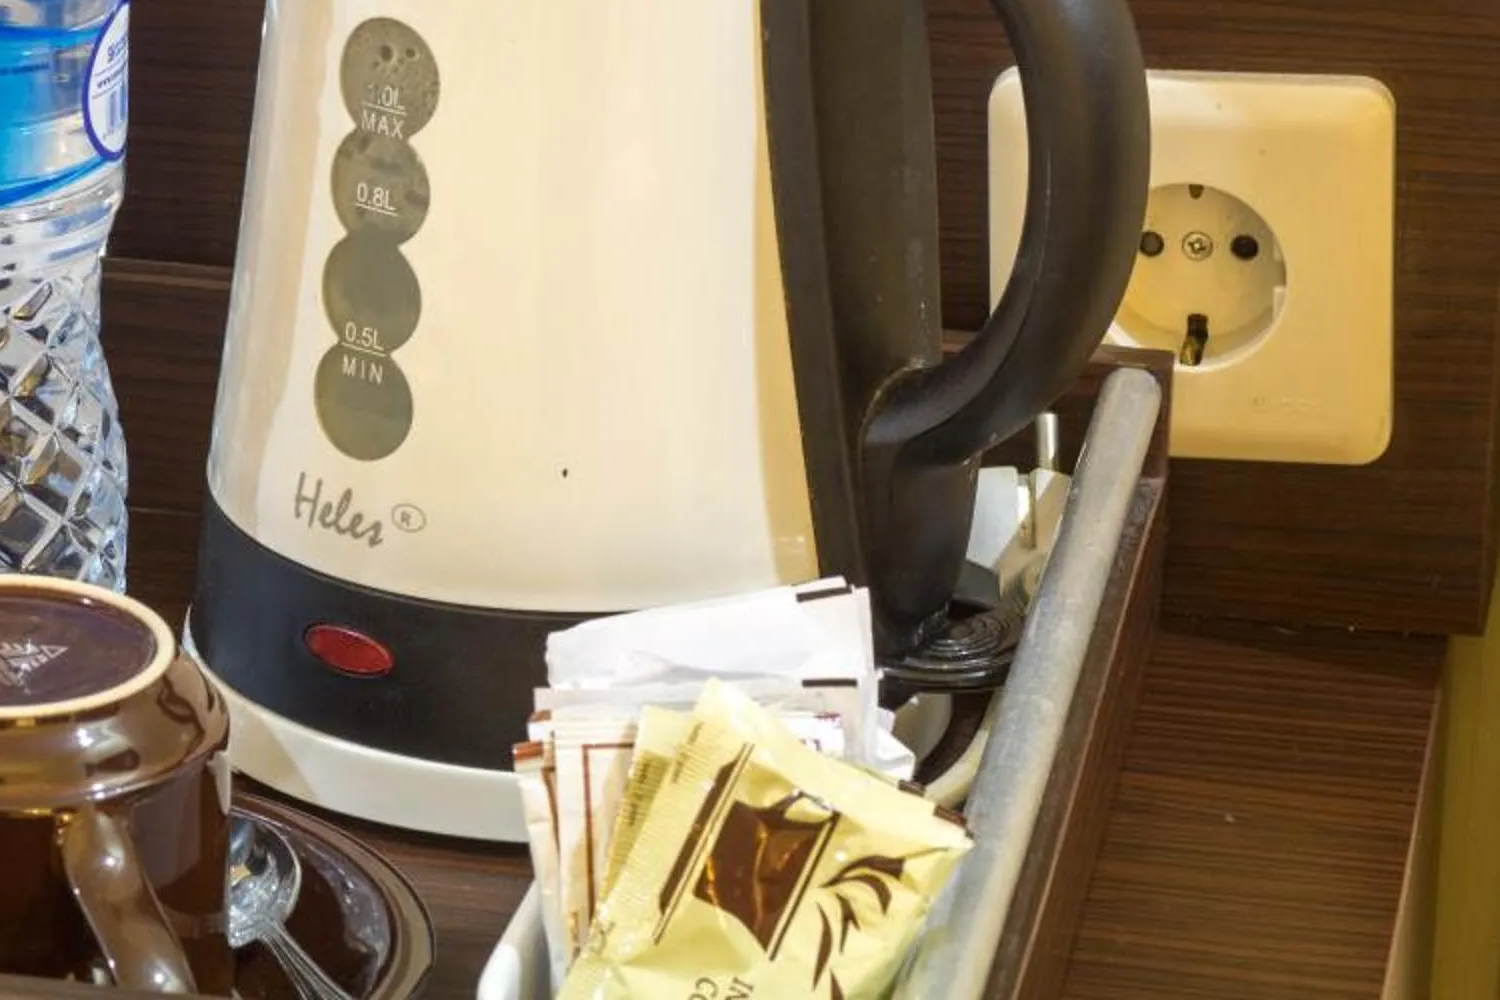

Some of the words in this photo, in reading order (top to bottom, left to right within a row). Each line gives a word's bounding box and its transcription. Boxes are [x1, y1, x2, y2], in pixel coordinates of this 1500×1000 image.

[361, 109, 405, 139] MAX
[357, 182, 397, 211] 0.8L
[345, 321, 385, 351] 0.5L
[342, 353, 383, 385] MIN
[294, 471, 384, 549] Heles
